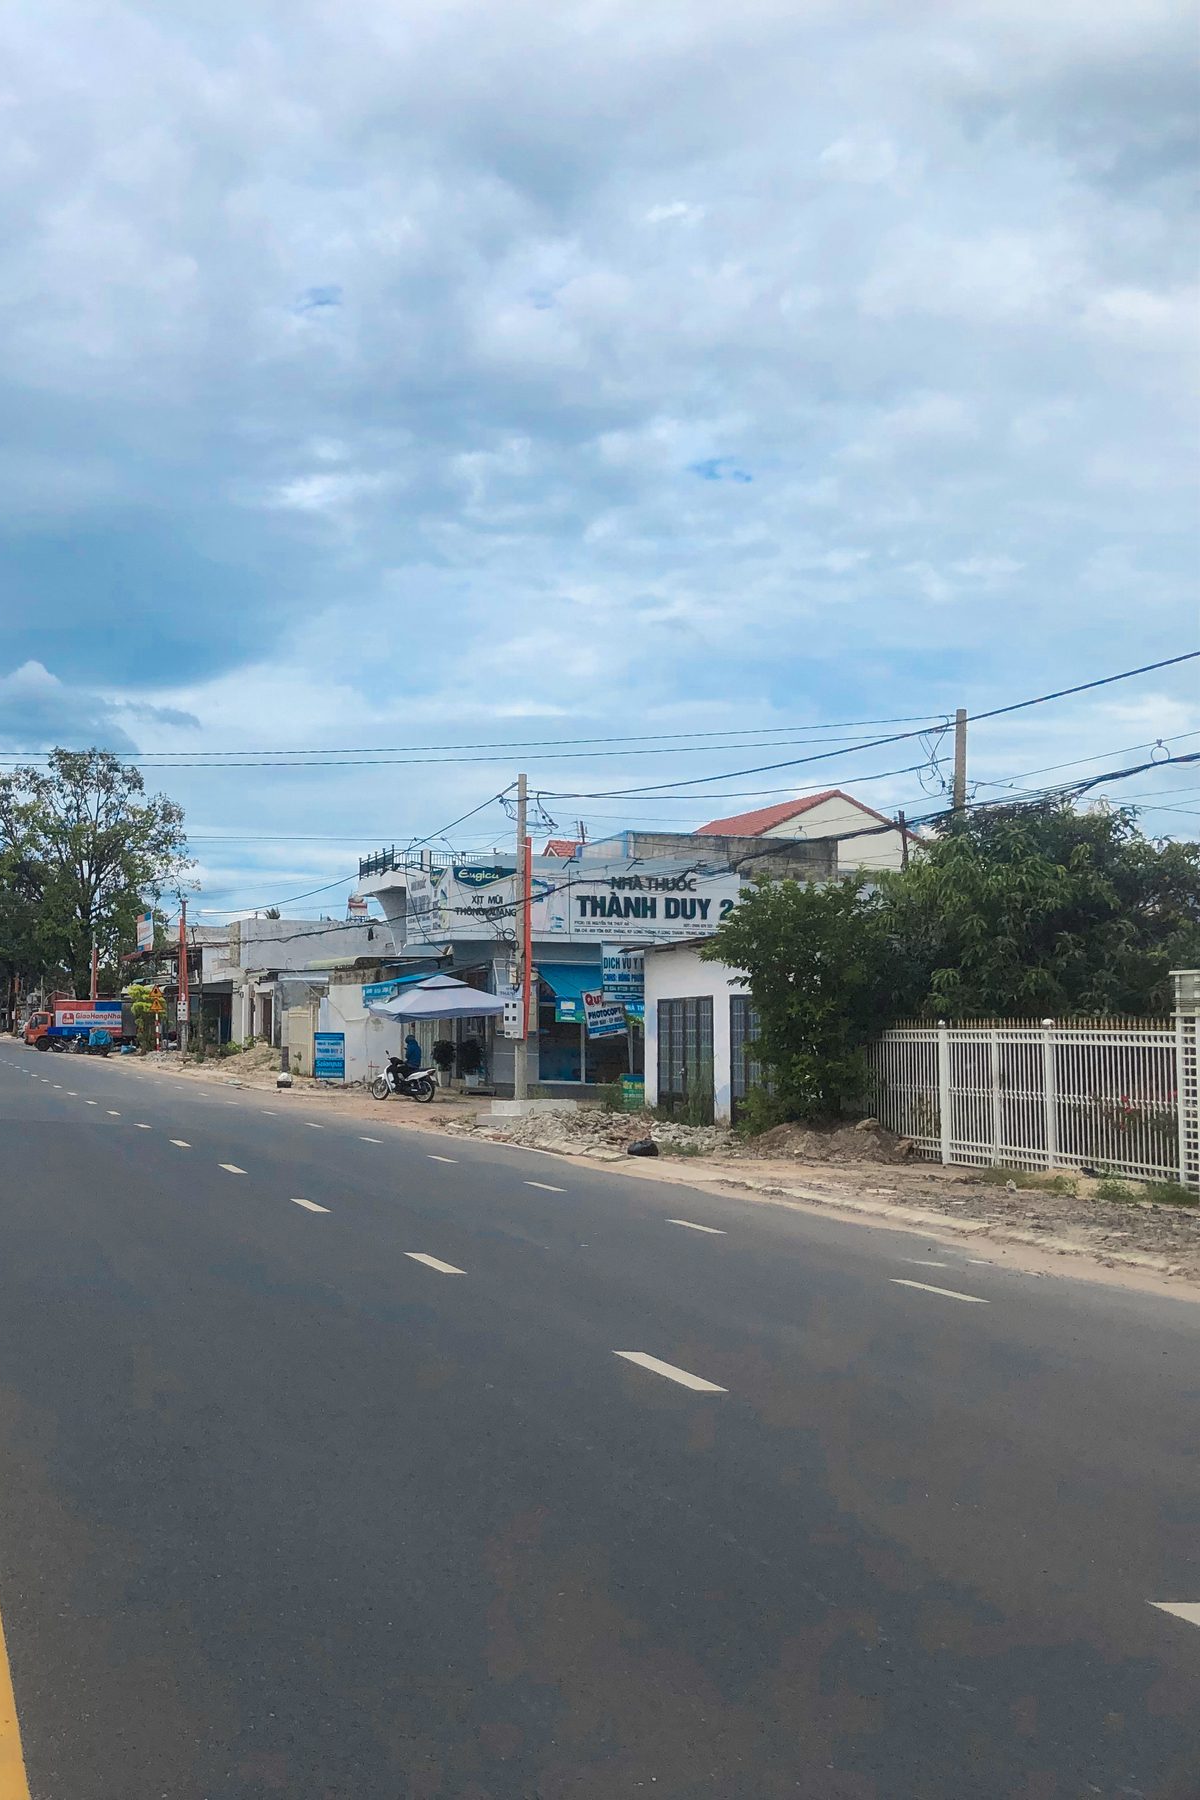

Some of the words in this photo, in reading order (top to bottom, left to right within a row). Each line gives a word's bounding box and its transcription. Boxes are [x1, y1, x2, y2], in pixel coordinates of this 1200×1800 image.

[458, 868, 499, 881] Eugica
[611, 874, 643, 890] NHÀ
[645, 876, 697, 892] THUỐC
[576, 891, 657, 919] THÀNH
[664, 897, 712, 920] DUY
[719, 899, 734, 920] 2
[603, 957, 620, 972] DỊCH
[622, 957, 631, 972] VỤ
[632, 957, 638, 969] Y
